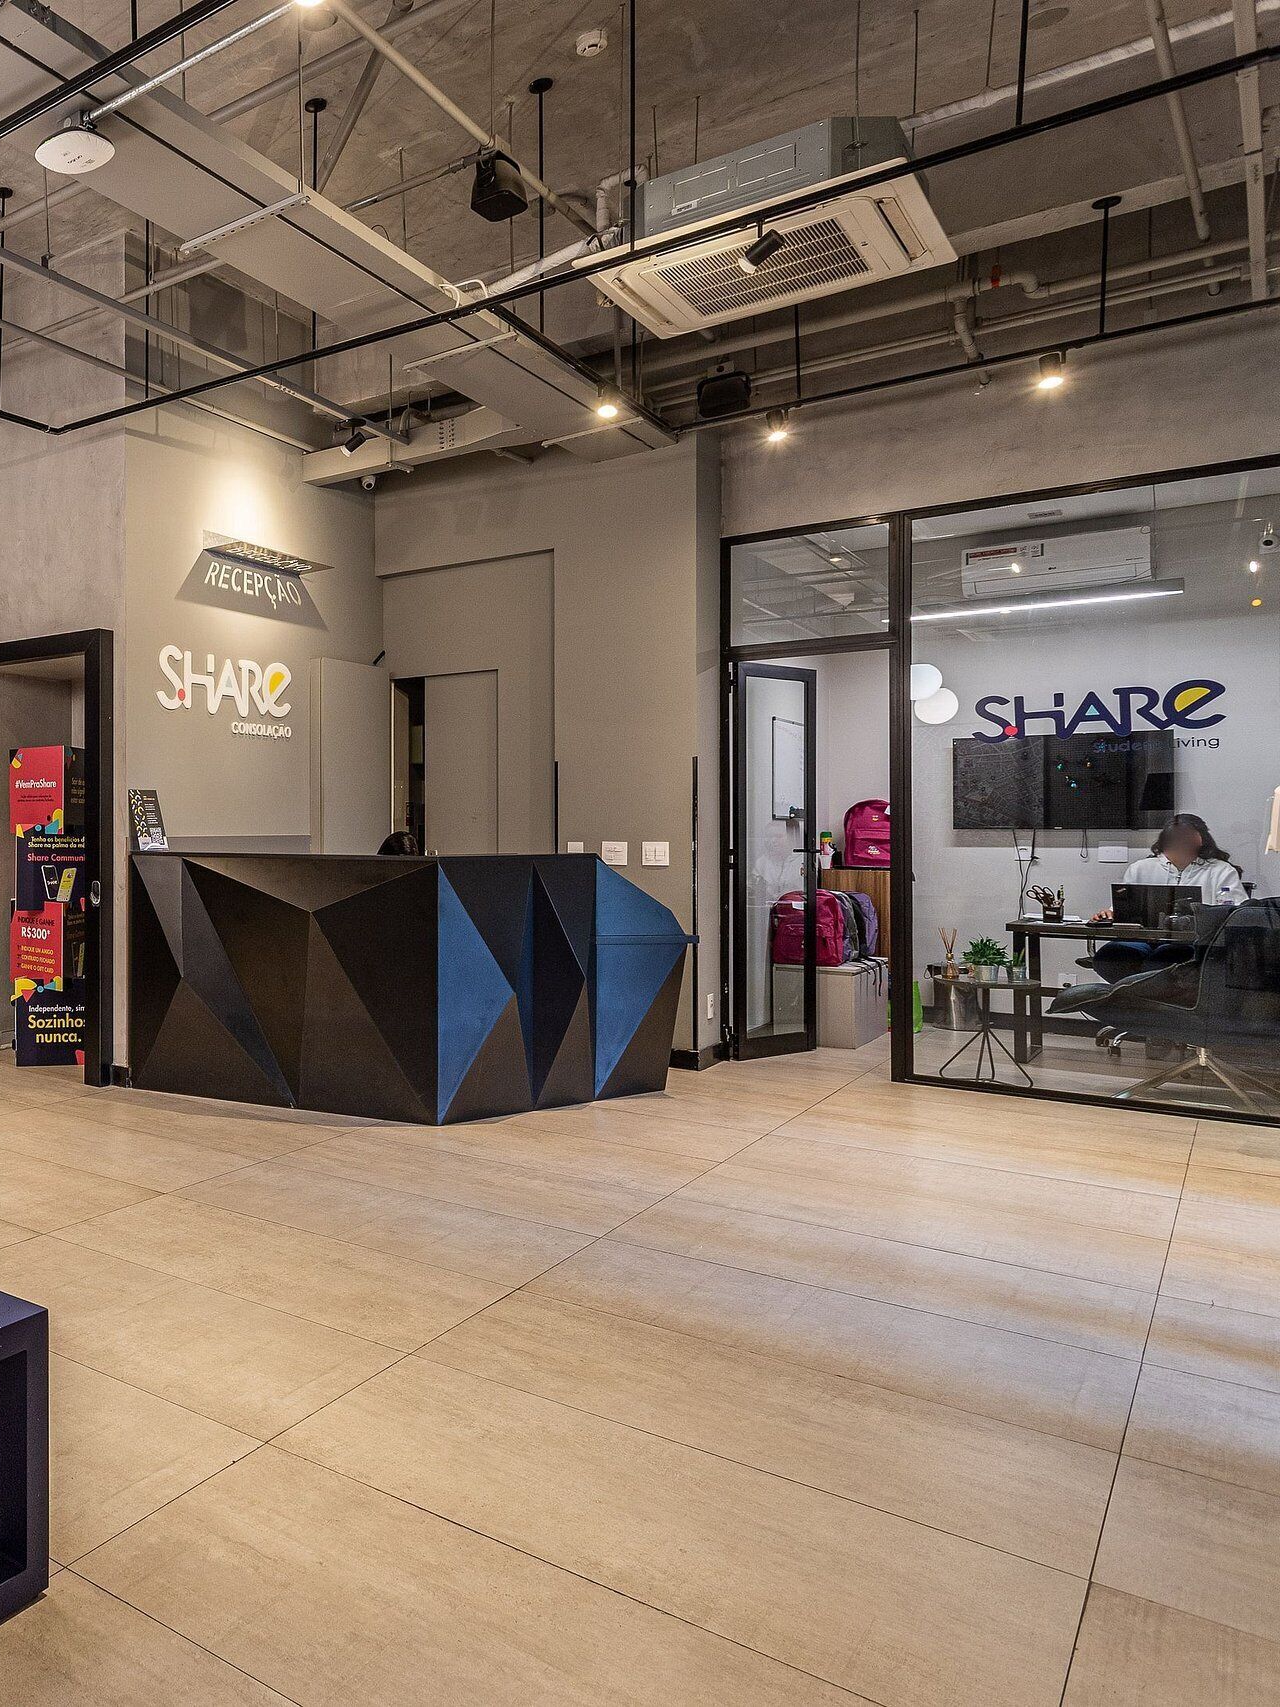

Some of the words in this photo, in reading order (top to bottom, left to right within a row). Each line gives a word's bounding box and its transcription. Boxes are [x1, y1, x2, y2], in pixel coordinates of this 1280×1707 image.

[204, 561, 301, 610] RECEPÇÃO
[231, 722, 292, 740] CONSOLAÇÃO
[27, 852, 49, 862] Share
[29, 1004, 74, 1013] Independente,
[36, 1032, 82, 1043] nunca.
